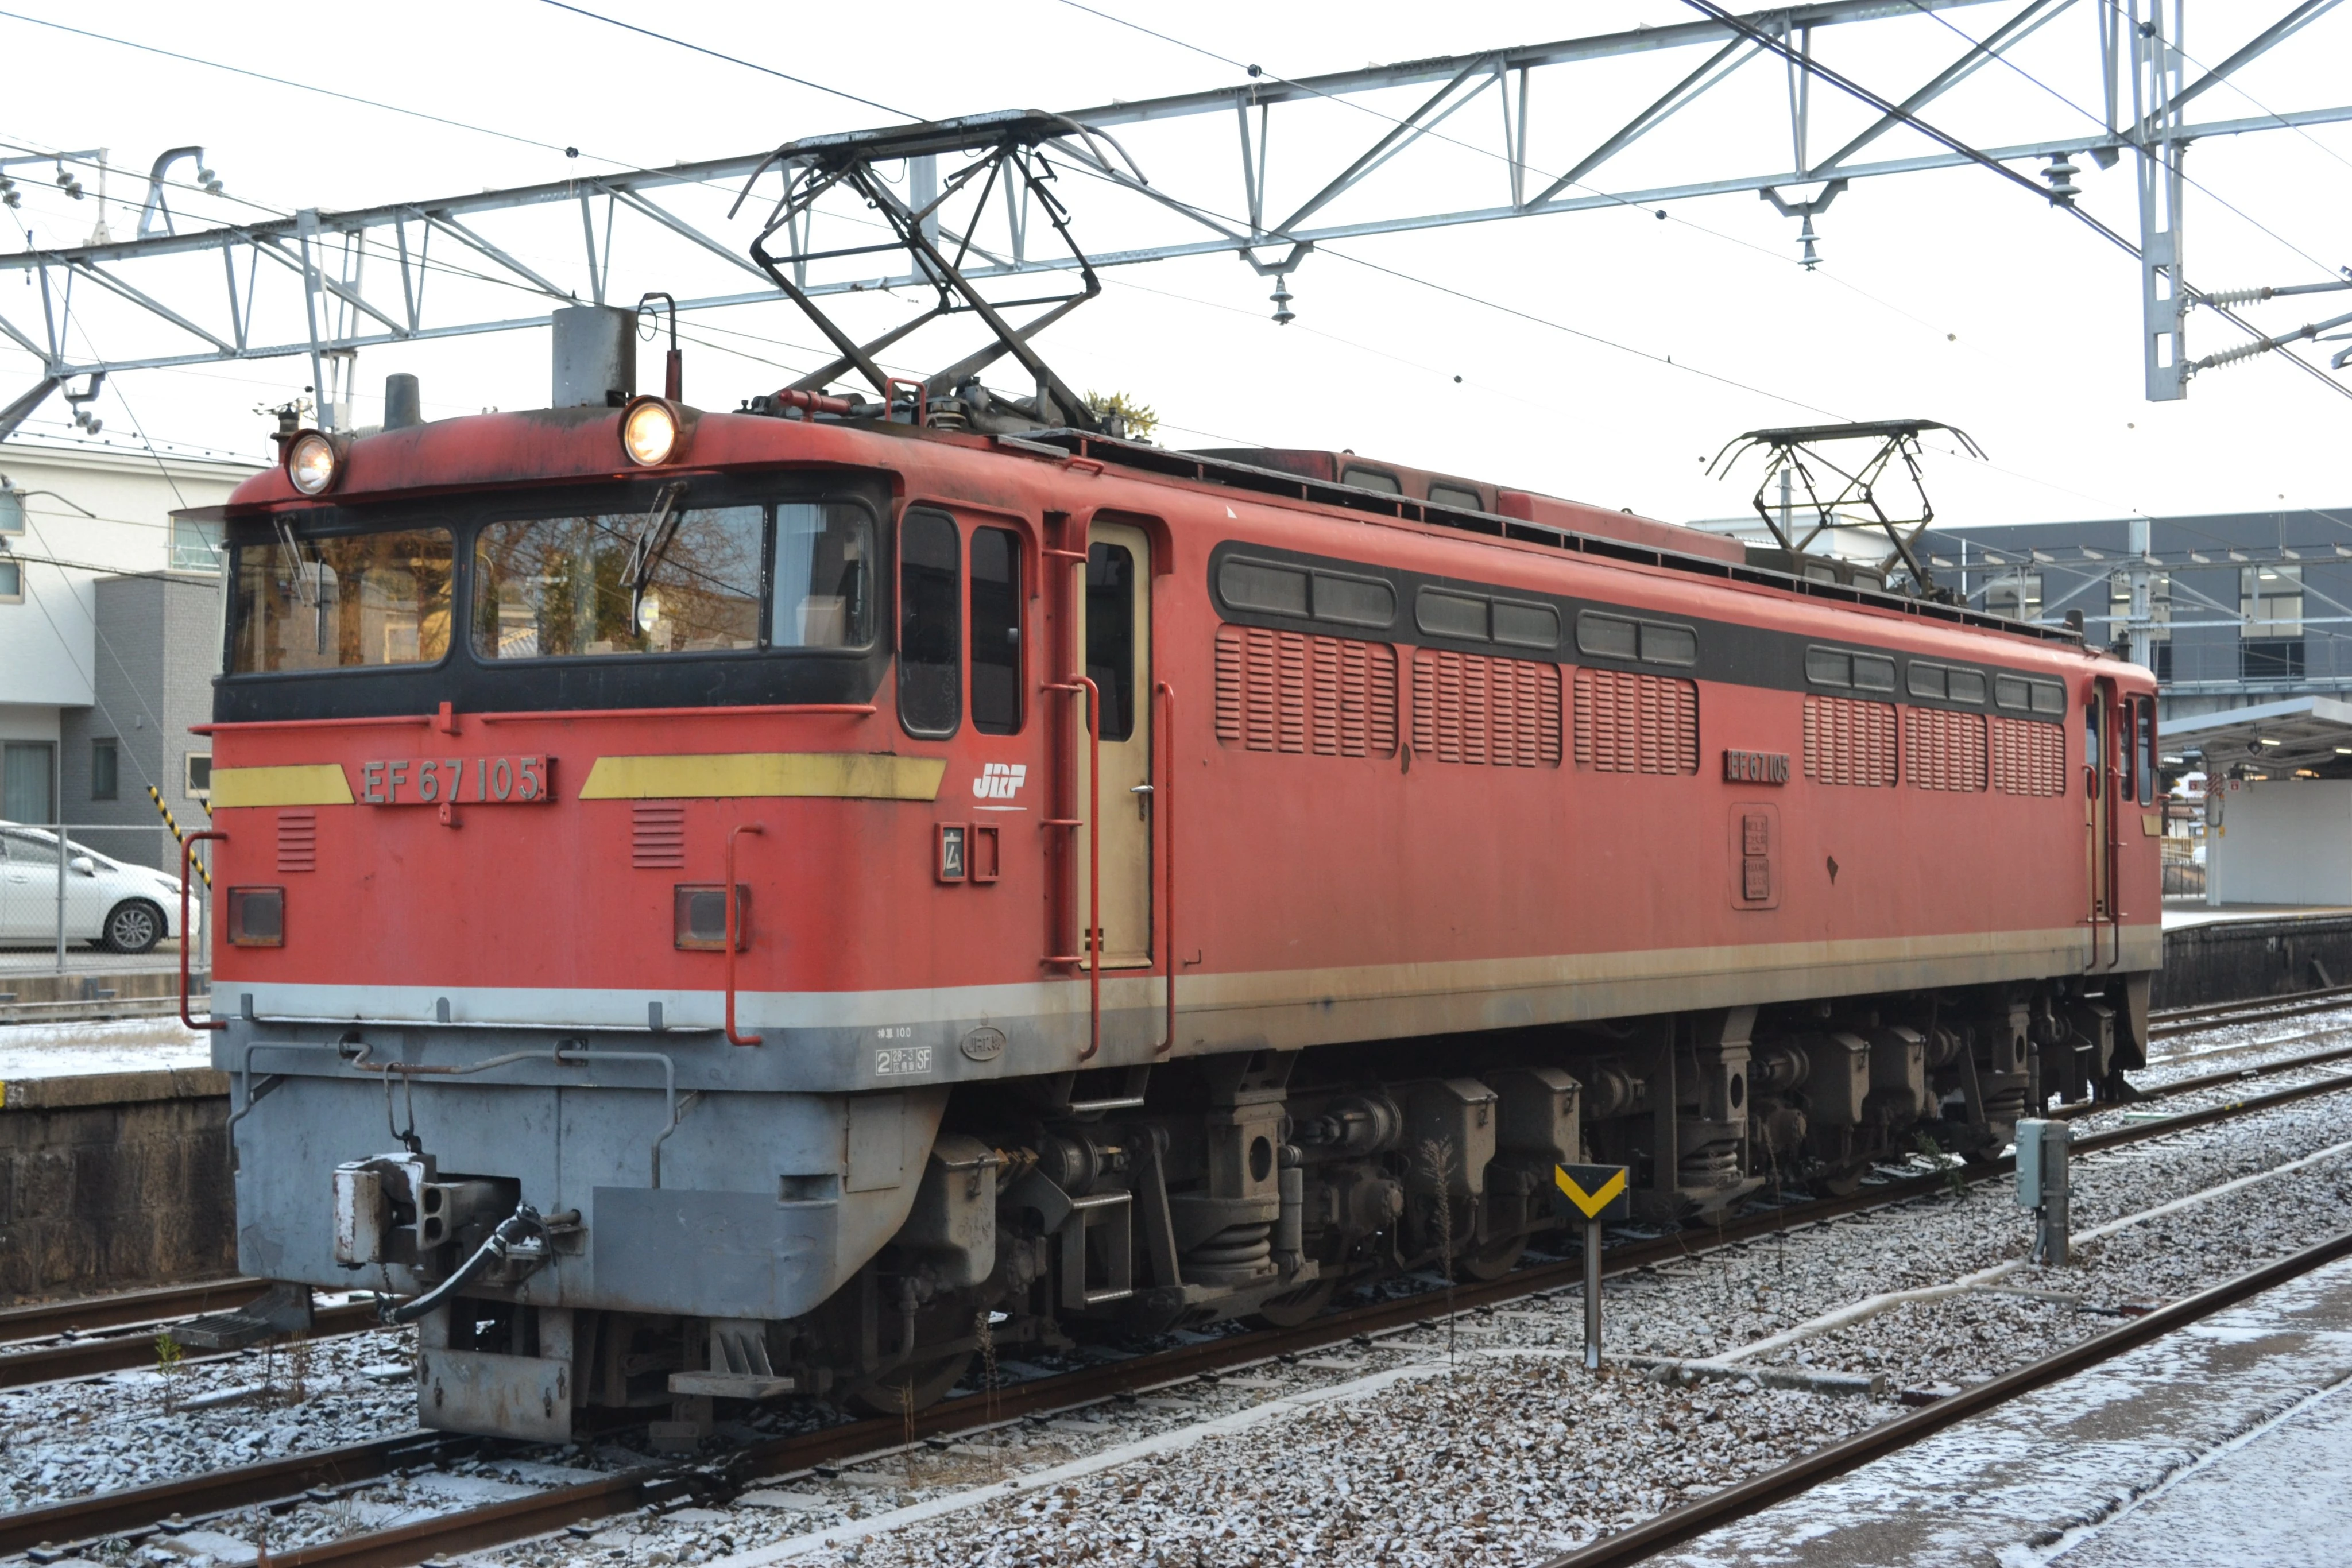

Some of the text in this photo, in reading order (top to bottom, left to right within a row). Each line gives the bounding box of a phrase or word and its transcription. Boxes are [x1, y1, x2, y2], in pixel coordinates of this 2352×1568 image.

[478, 757, 539, 800] 105
[973, 763, 1027, 799] JRF
[1769, 754, 1789, 781] 105
[943, 832, 961, 872] 広
[877, 1052, 890, 1073] 2
[917, 1049, 930, 1070] SF
